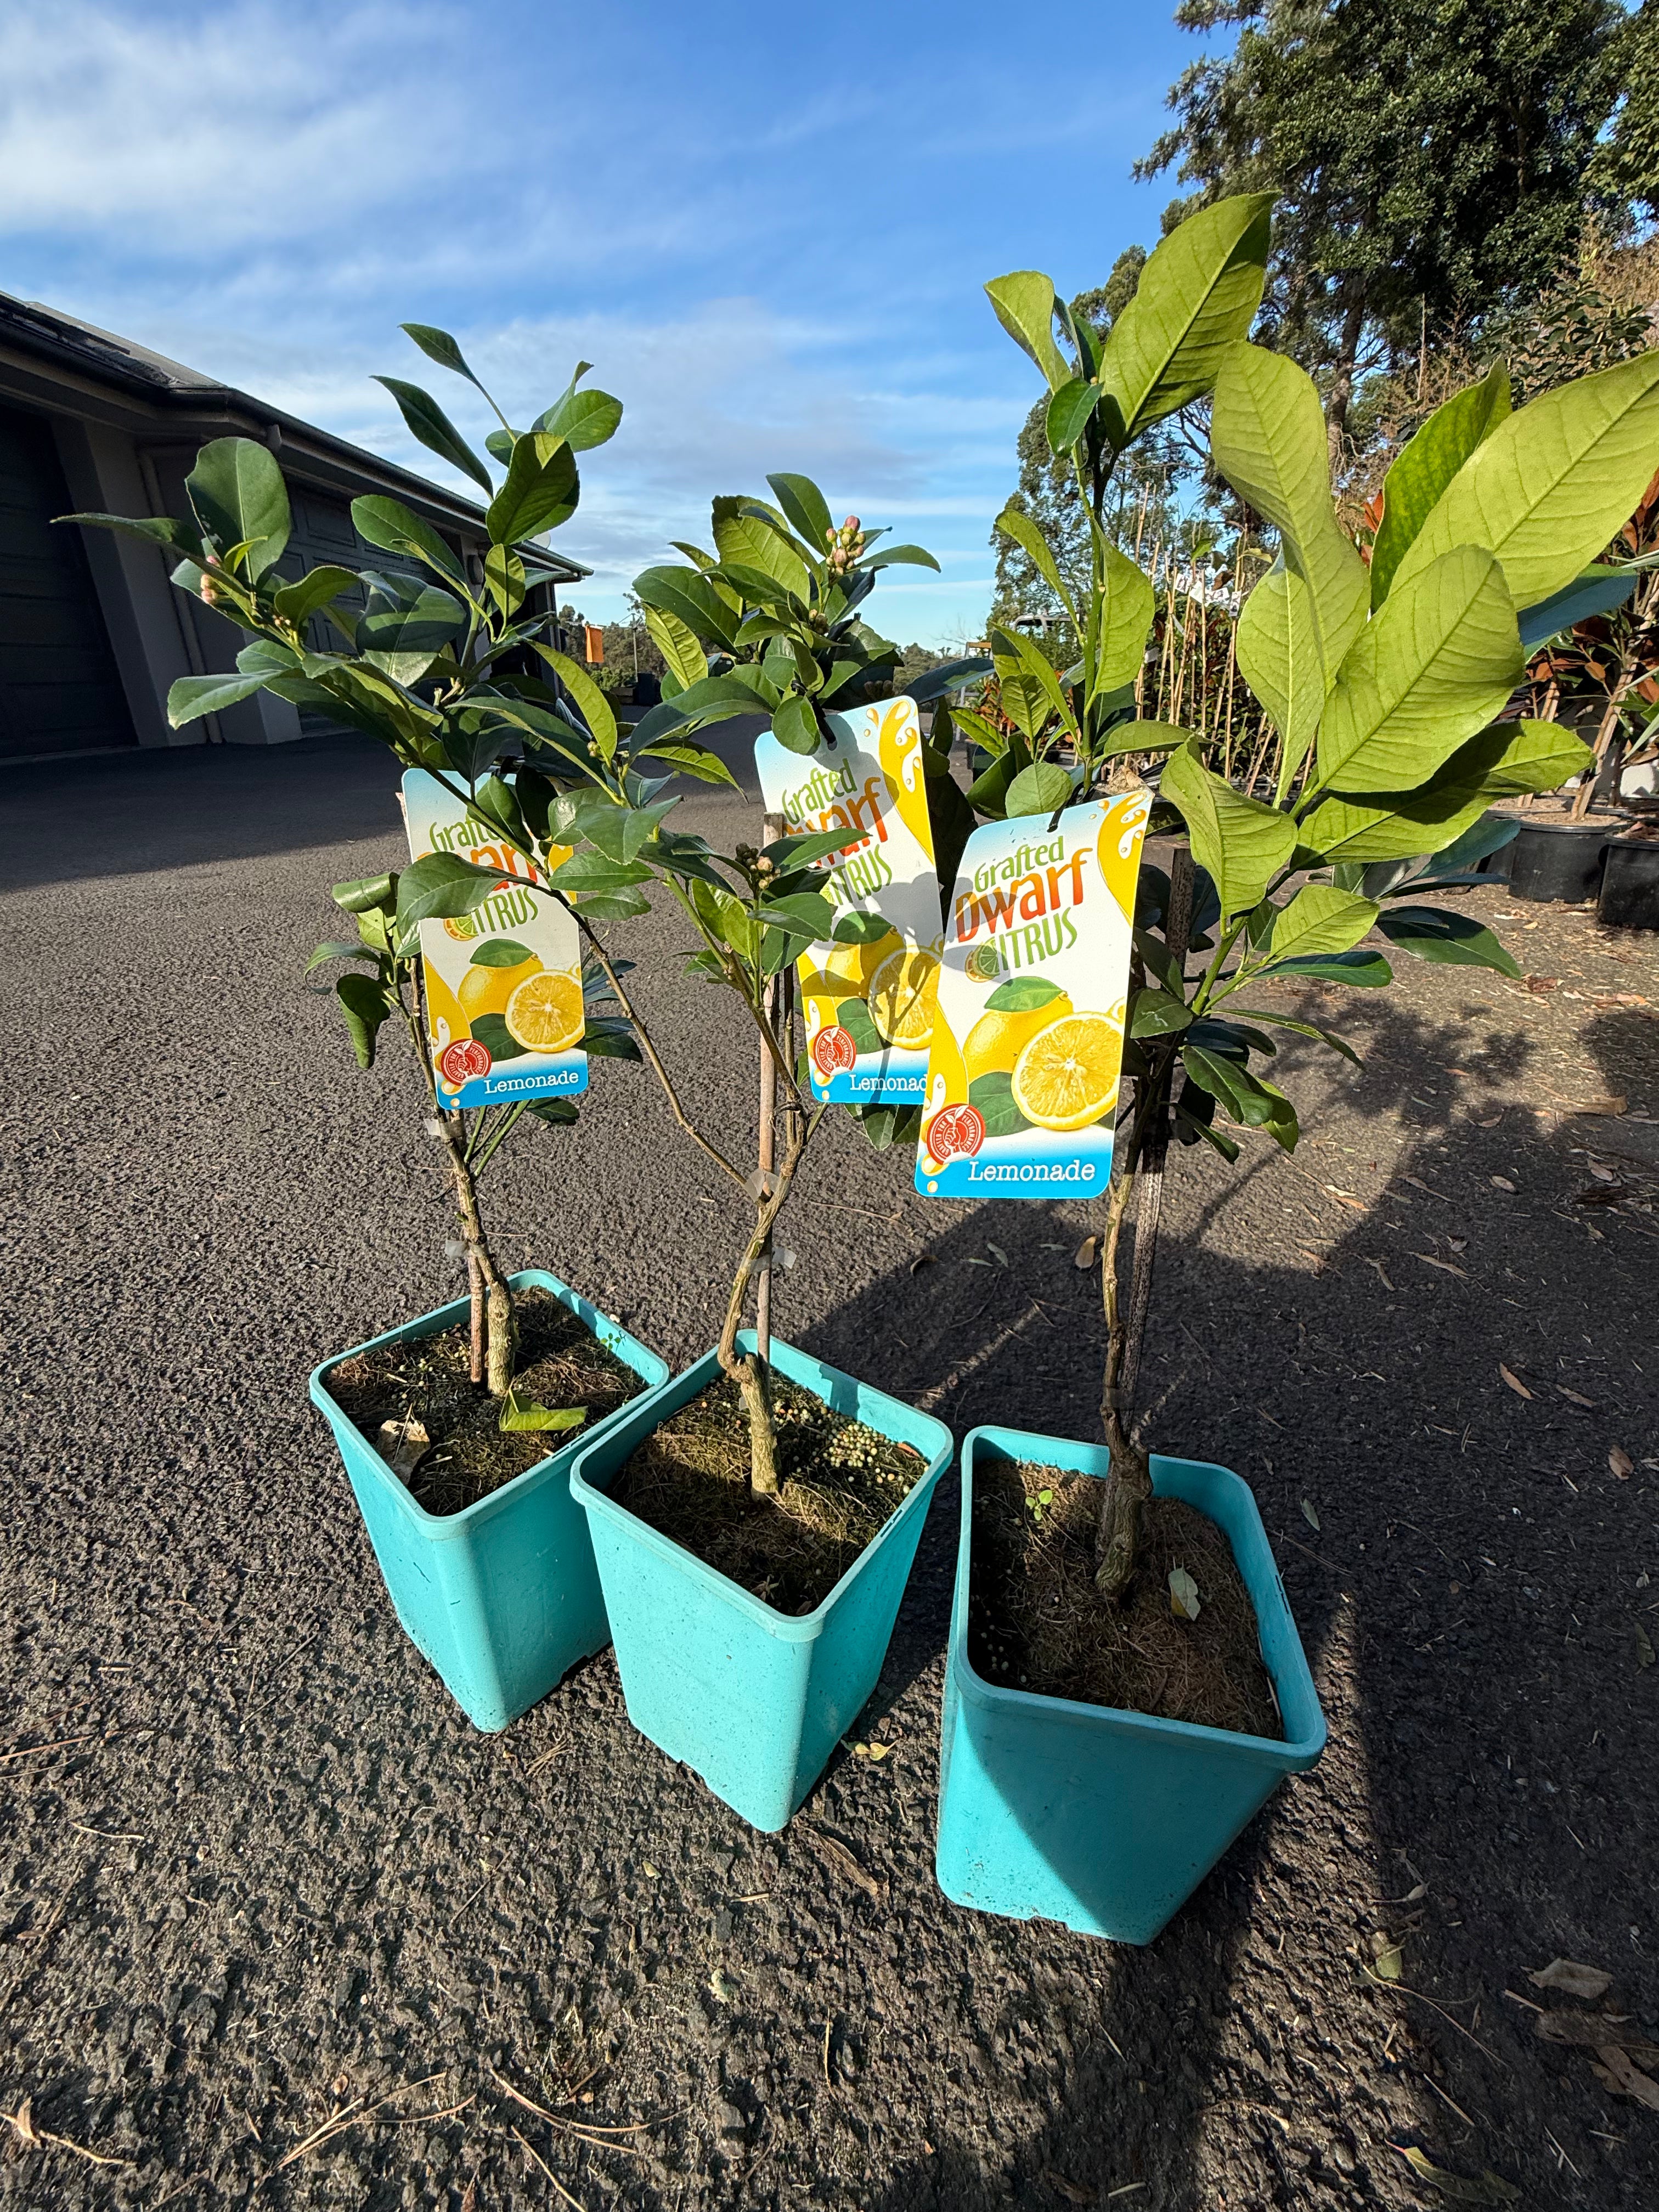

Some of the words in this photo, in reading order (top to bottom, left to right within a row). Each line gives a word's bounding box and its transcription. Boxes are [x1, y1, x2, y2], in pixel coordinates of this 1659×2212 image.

[782, 758, 857, 825] Grafted
[785, 776, 888, 868] arf
[955, 848, 1093, 943] Dwarf
[974, 836, 1064, 893] Grafted
[977, 907, 1077, 977] CITRUS
[483, 1070, 579, 1094] Lemonade
[849, 1074, 927, 1092] Lemonad
[967, 1159, 1096, 1182] Lemonade
